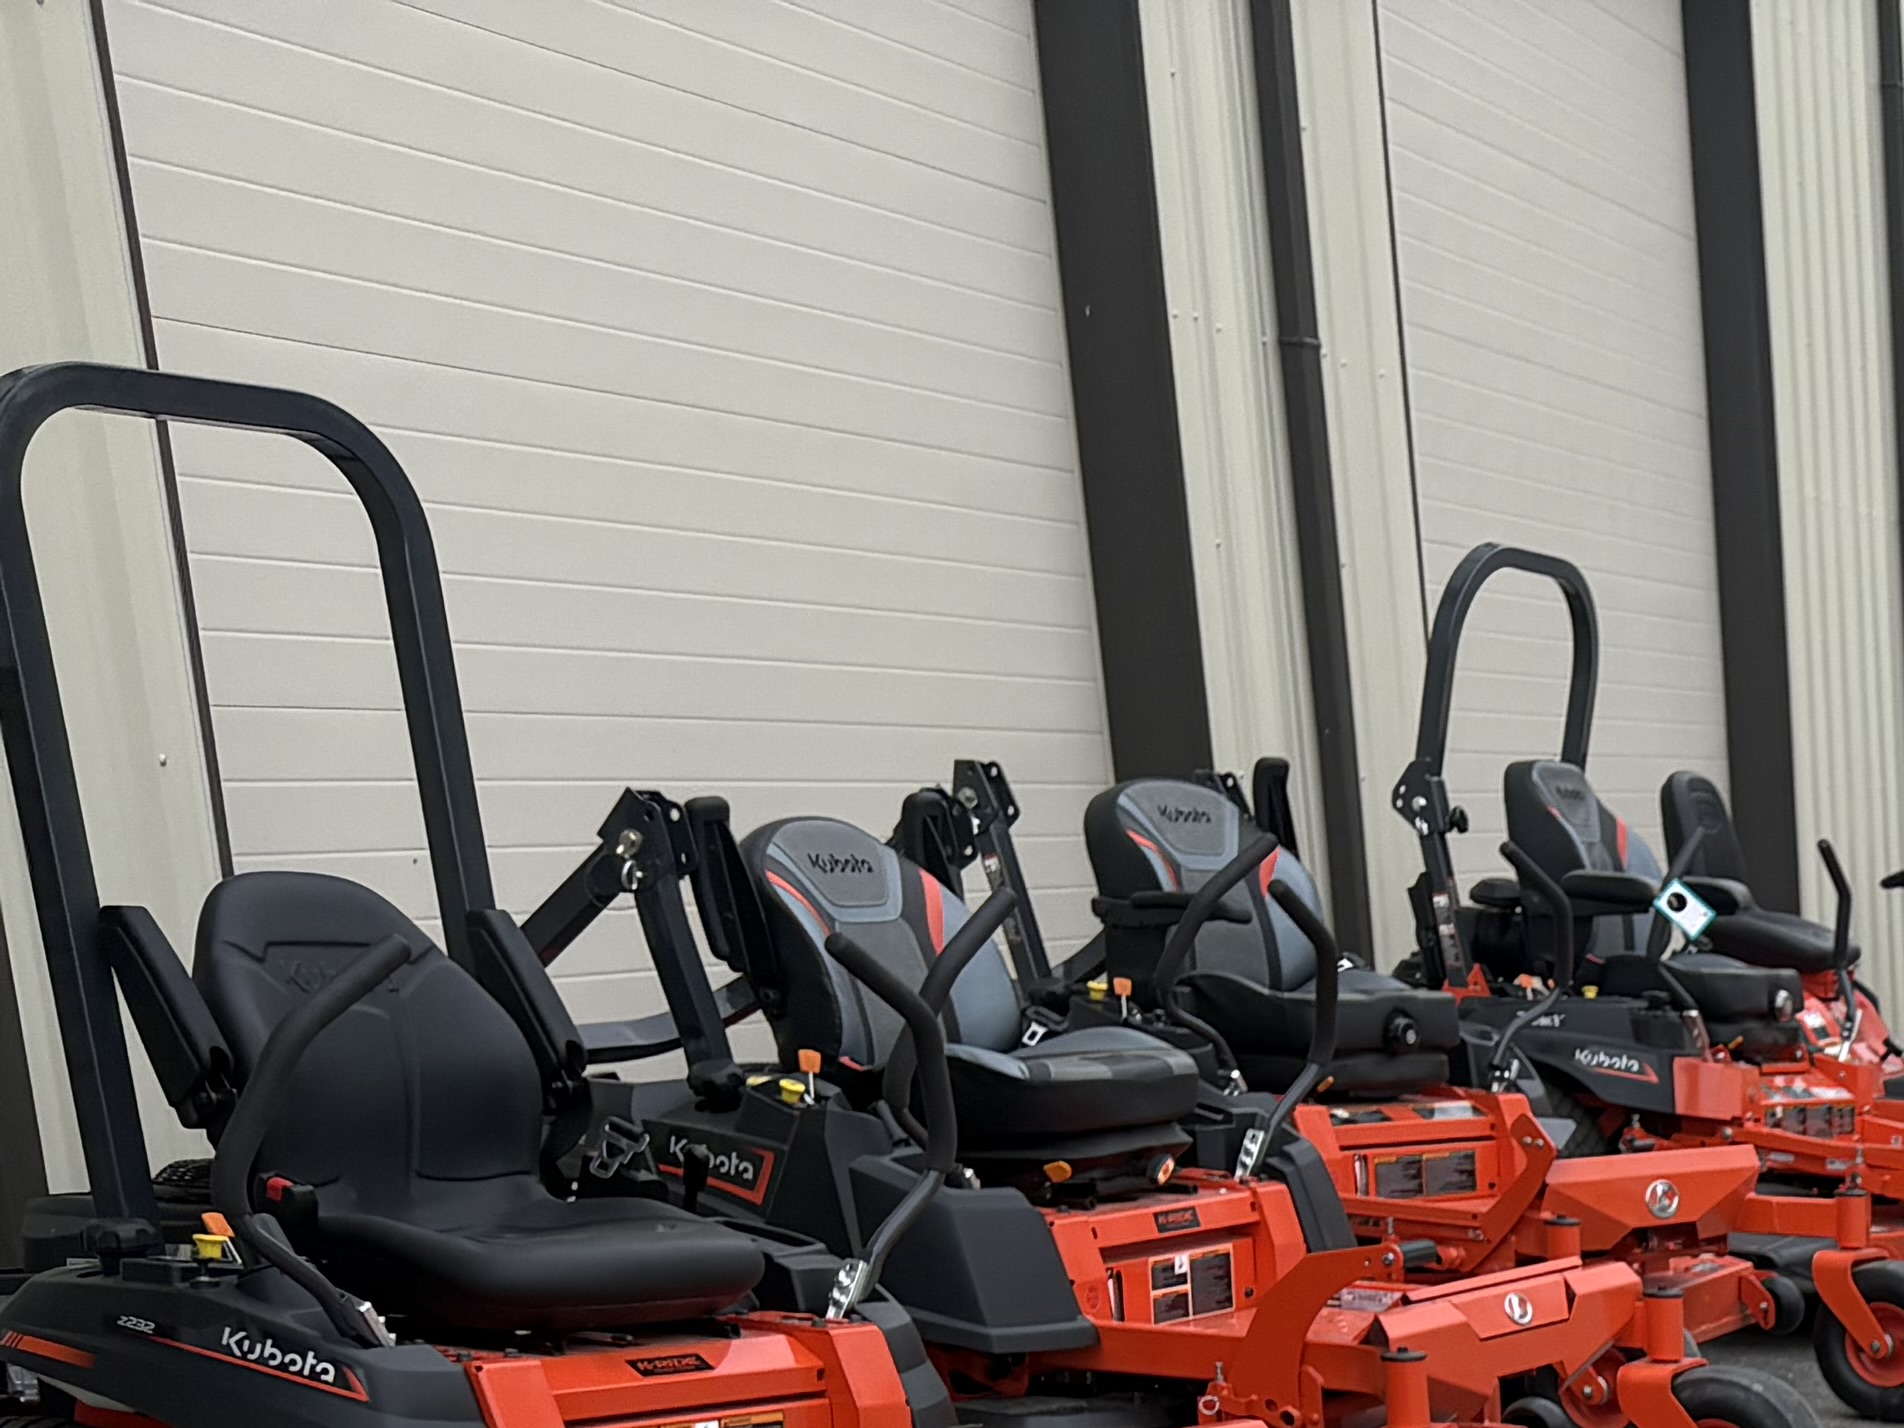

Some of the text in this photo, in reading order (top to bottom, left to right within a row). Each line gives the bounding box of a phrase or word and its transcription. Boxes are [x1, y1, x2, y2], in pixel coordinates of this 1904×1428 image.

[807, 852, 874, 874] Kubota
[1574, 1048, 1640, 1072] Kubota
[669, 1135, 754, 1180] Kota
[221, 1326, 336, 1384] Kubota
